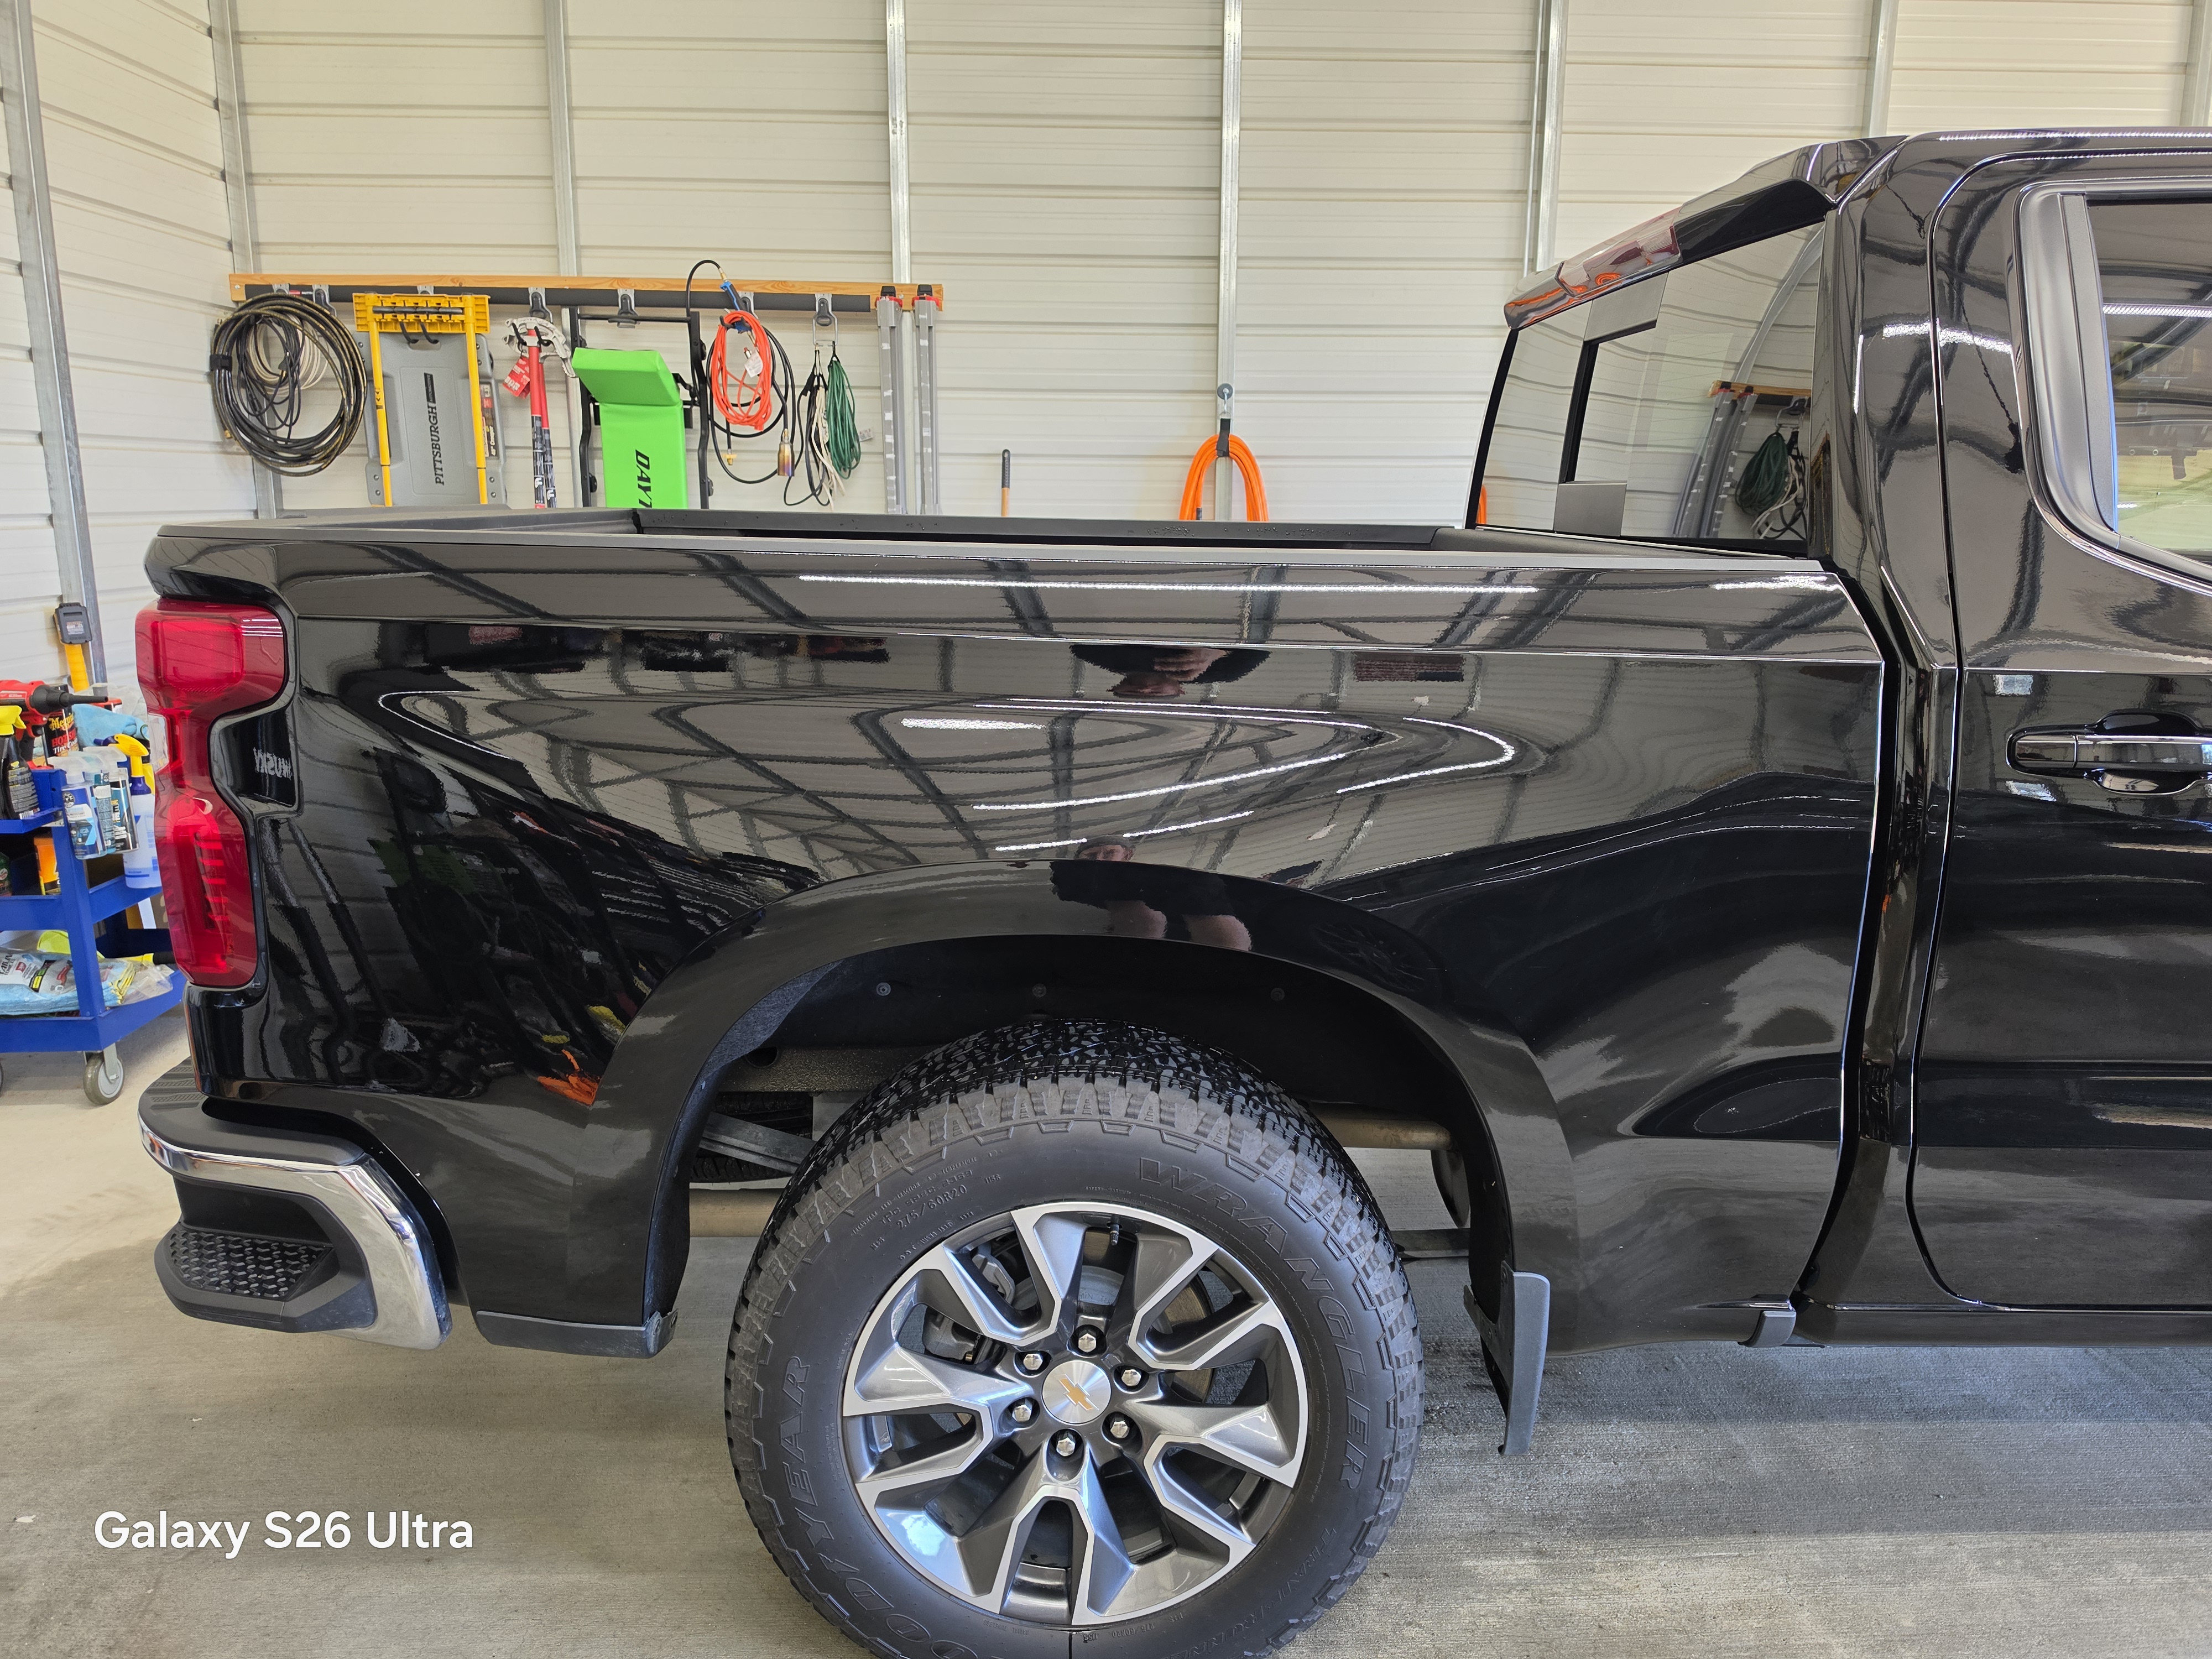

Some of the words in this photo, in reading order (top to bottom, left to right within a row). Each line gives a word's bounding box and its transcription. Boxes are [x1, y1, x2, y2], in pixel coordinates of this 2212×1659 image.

[427, 403, 445, 486] PITTSBURGH
[896, 1185, 968, 1229] 275/60R20
[1140, 1157, 1370, 1490] WRANGLER
[780, 1356, 1006, 1659] OODYEAR
